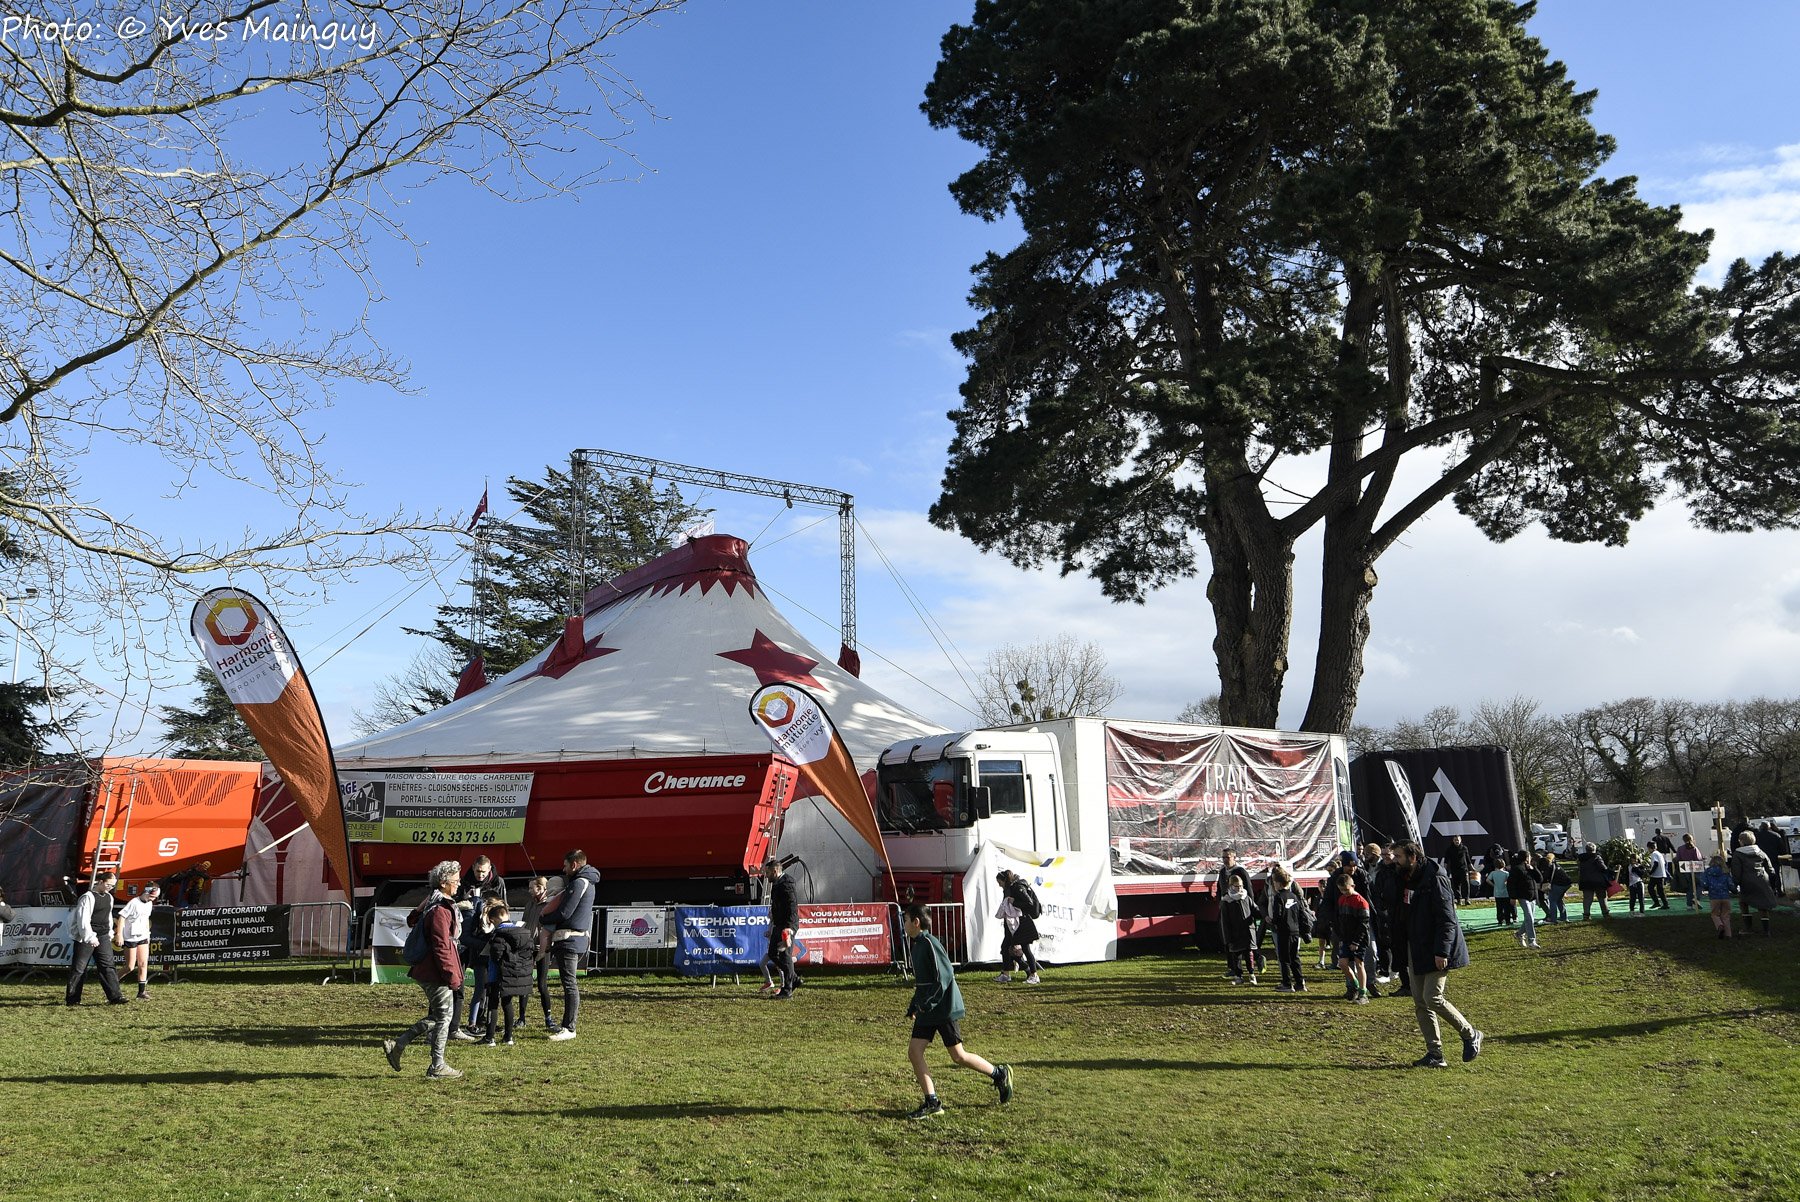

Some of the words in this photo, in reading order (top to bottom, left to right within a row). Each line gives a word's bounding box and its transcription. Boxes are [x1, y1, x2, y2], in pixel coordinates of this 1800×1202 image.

[216, 632, 277, 670] Harmonie
[221, 641, 283, 680] mutuelle
[774, 708, 813, 744] Harmonie
[781, 713, 819, 750] mutuelle
[644, 771, 746, 794] Chevance
[1203, 763, 1254, 791] TRAIL
[340, 781, 358, 796] RGE
[388, 782, 422, 792] FENÊTRES
[428, 784, 461, 792] CLOISONS
[462, 782, 488, 792] SÈCHES
[494, 784, 528, 792] ISOLATION
[438, 794, 472, 804] CLÔTURES
[1203, 791, 1255, 815] GLAZIG
[395, 808, 517, 818] menuiserielebars@outlook.fr
[444, 821, 466, 830] 22290
[412, 831, 427, 842] 02
[430, 831, 444, 842] 96
[446, 831, 462, 842] 33
[465, 831, 480, 842] 73
[482, 831, 496, 842] 66
[182, 909, 216, 917] PEINTURE
[222, 906, 268, 916] DECORATION
[1041, 904, 1074, 920] APELET
[181, 918, 231, 928] REVÊTEMENTS
[232, 916, 265, 924] MURAUX
[684, 916, 746, 926] STEPHANE
[748, 916, 770, 926] ORY
[4, 922, 62, 936] DIOACTIV
[181, 930, 198, 938] SOLS
[200, 928, 230, 937] SOUPLES
[238, 926, 274, 934] PARQUETS
[683, 928, 736, 938] IMMOBILIER
[181, 939, 228, 948] RAVALEMENT
[164, 954, 190, 962] ETABLES
[192, 952, 216, 962] S/MER
[222, 951, 231, 959] 02
